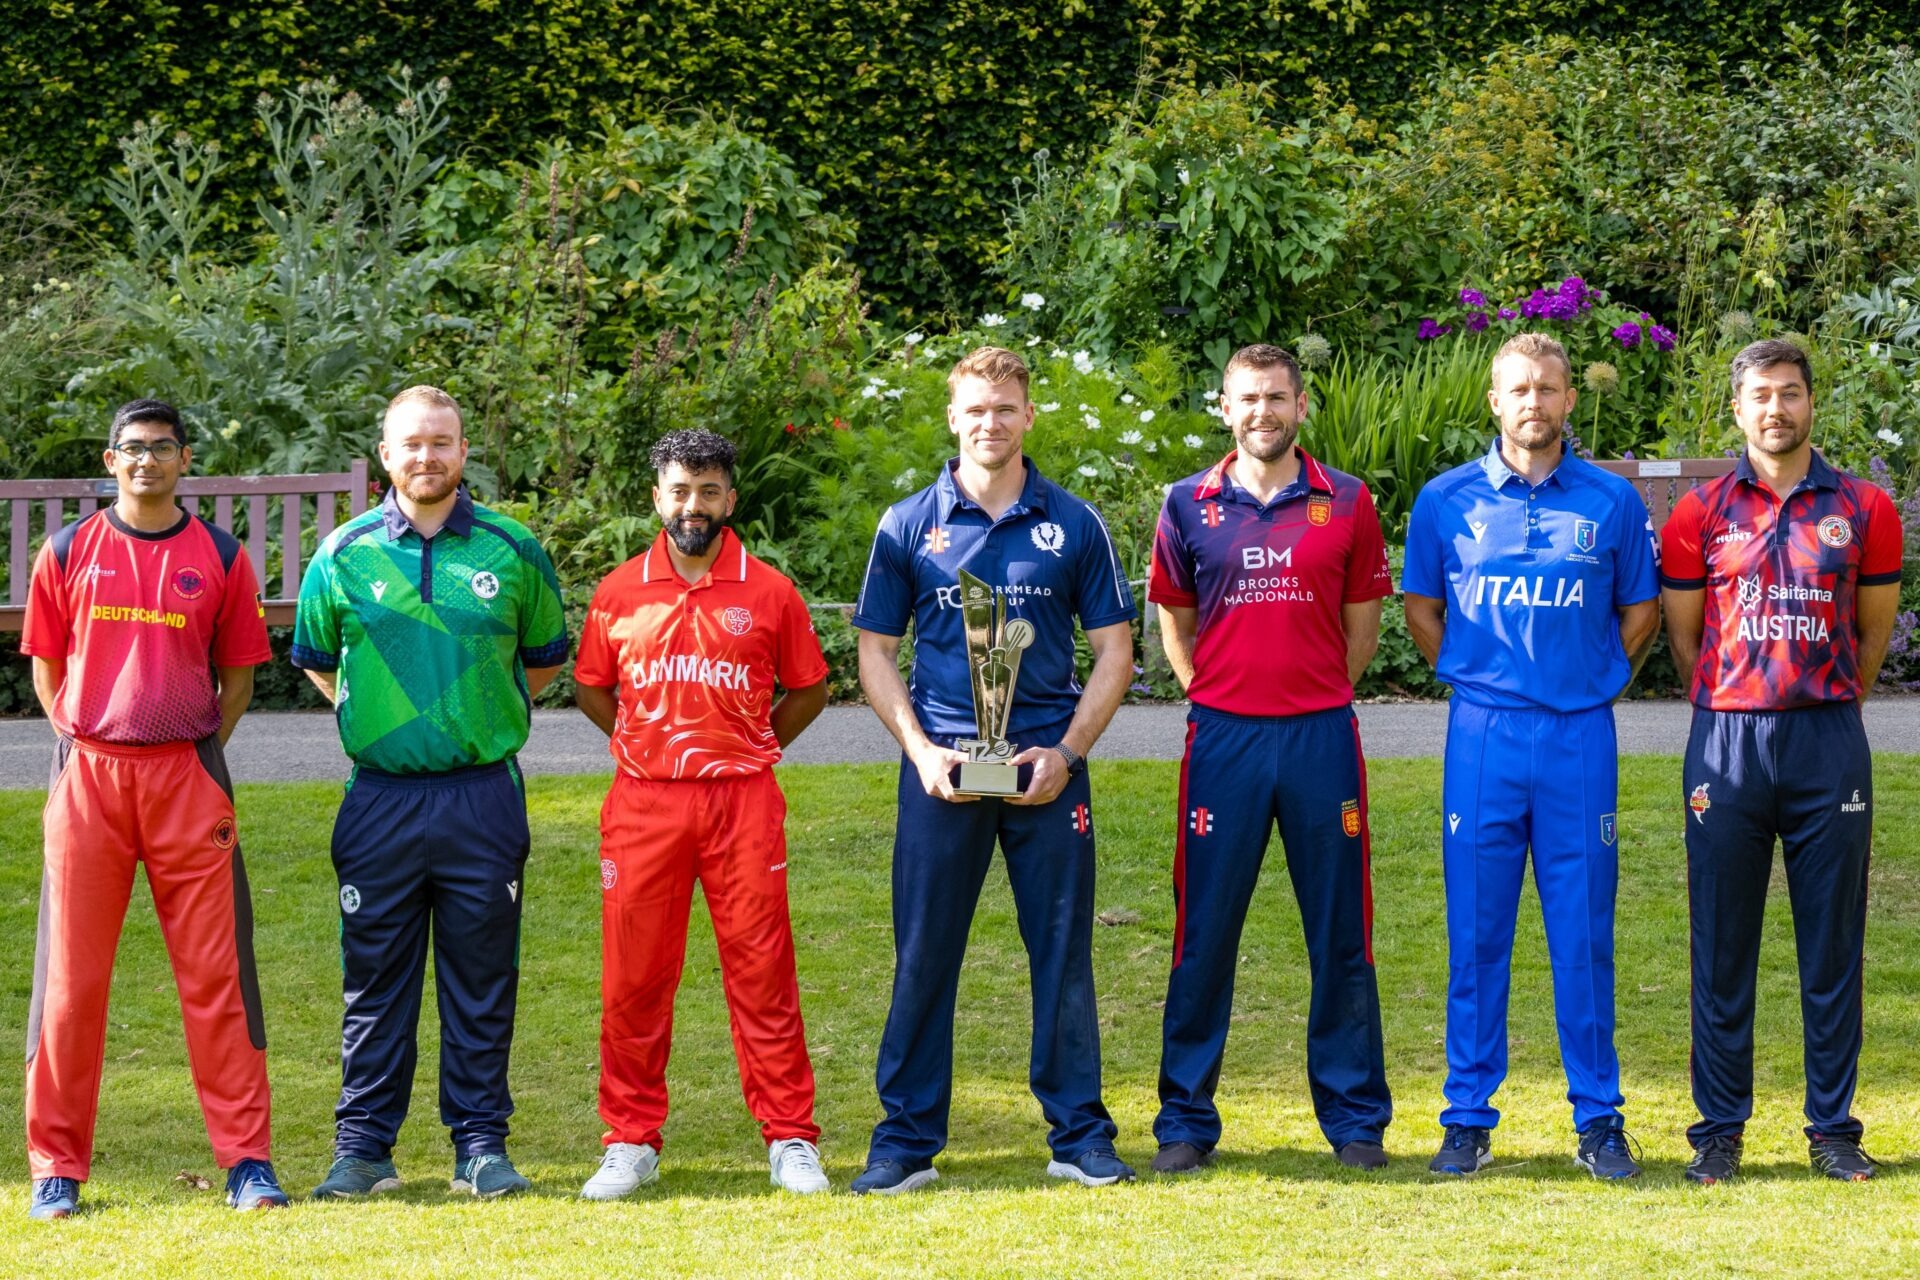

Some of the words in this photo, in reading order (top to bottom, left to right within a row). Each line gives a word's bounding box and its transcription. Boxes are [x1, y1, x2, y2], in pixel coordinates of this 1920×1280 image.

[1716, 531, 1752, 544] HUNT
[1242, 546, 1292, 569] BM
[989, 585, 1052, 597] RKMEAD
[1238, 576, 1299, 591] BROOKS
[1475, 575, 1584, 608] ITALIA
[1224, 590, 1314, 606] MACDONALD
[1768, 584, 1833, 603] Saitama
[91, 605, 186, 628] DEUTSCHLND
[1736, 615, 1830, 642] AUSTRIA
[1841, 802, 1866, 812] HUNT
